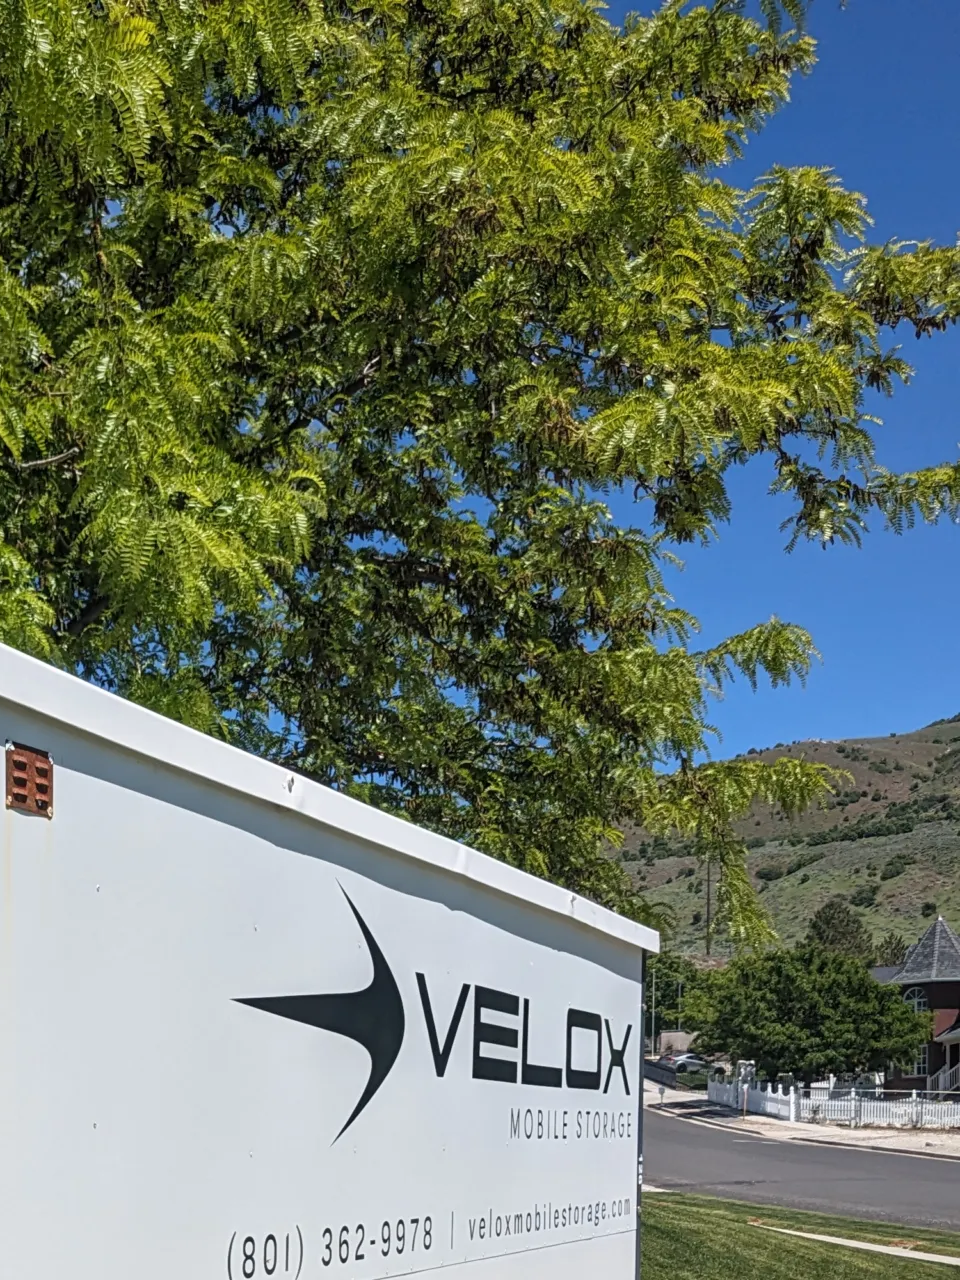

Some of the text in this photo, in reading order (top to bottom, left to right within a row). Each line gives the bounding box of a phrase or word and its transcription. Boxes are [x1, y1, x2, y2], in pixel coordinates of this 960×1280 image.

[415, 972, 633, 1095] VELOX
[510, 1108, 632, 1140] MOBILE STORAGE
[321, 1216, 433, 1267] 362-9978
[468, 1198, 631, 1241] veloxmobilestorage.com
